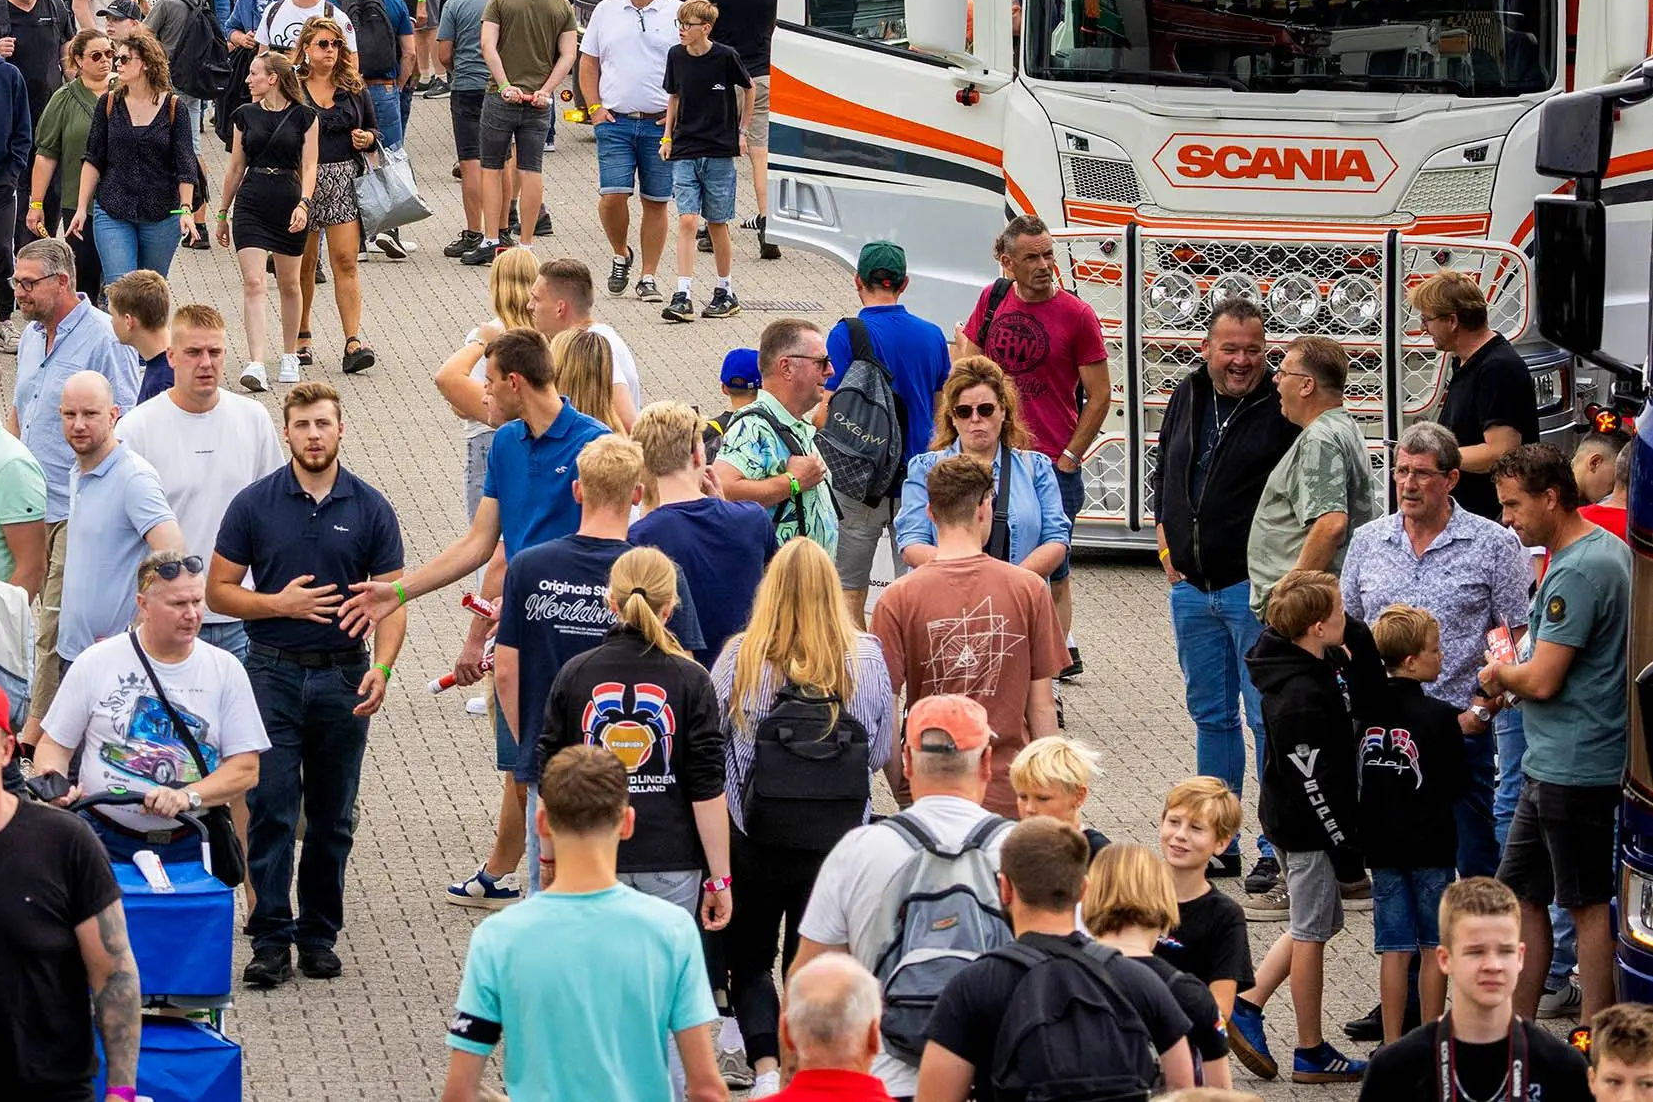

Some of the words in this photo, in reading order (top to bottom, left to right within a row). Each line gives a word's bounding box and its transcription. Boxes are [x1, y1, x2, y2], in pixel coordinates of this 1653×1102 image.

[1176, 144, 1376, 182] SCANIA
[539, 580, 593, 596] Originals
[638, 774, 677, 785] LINDEN
